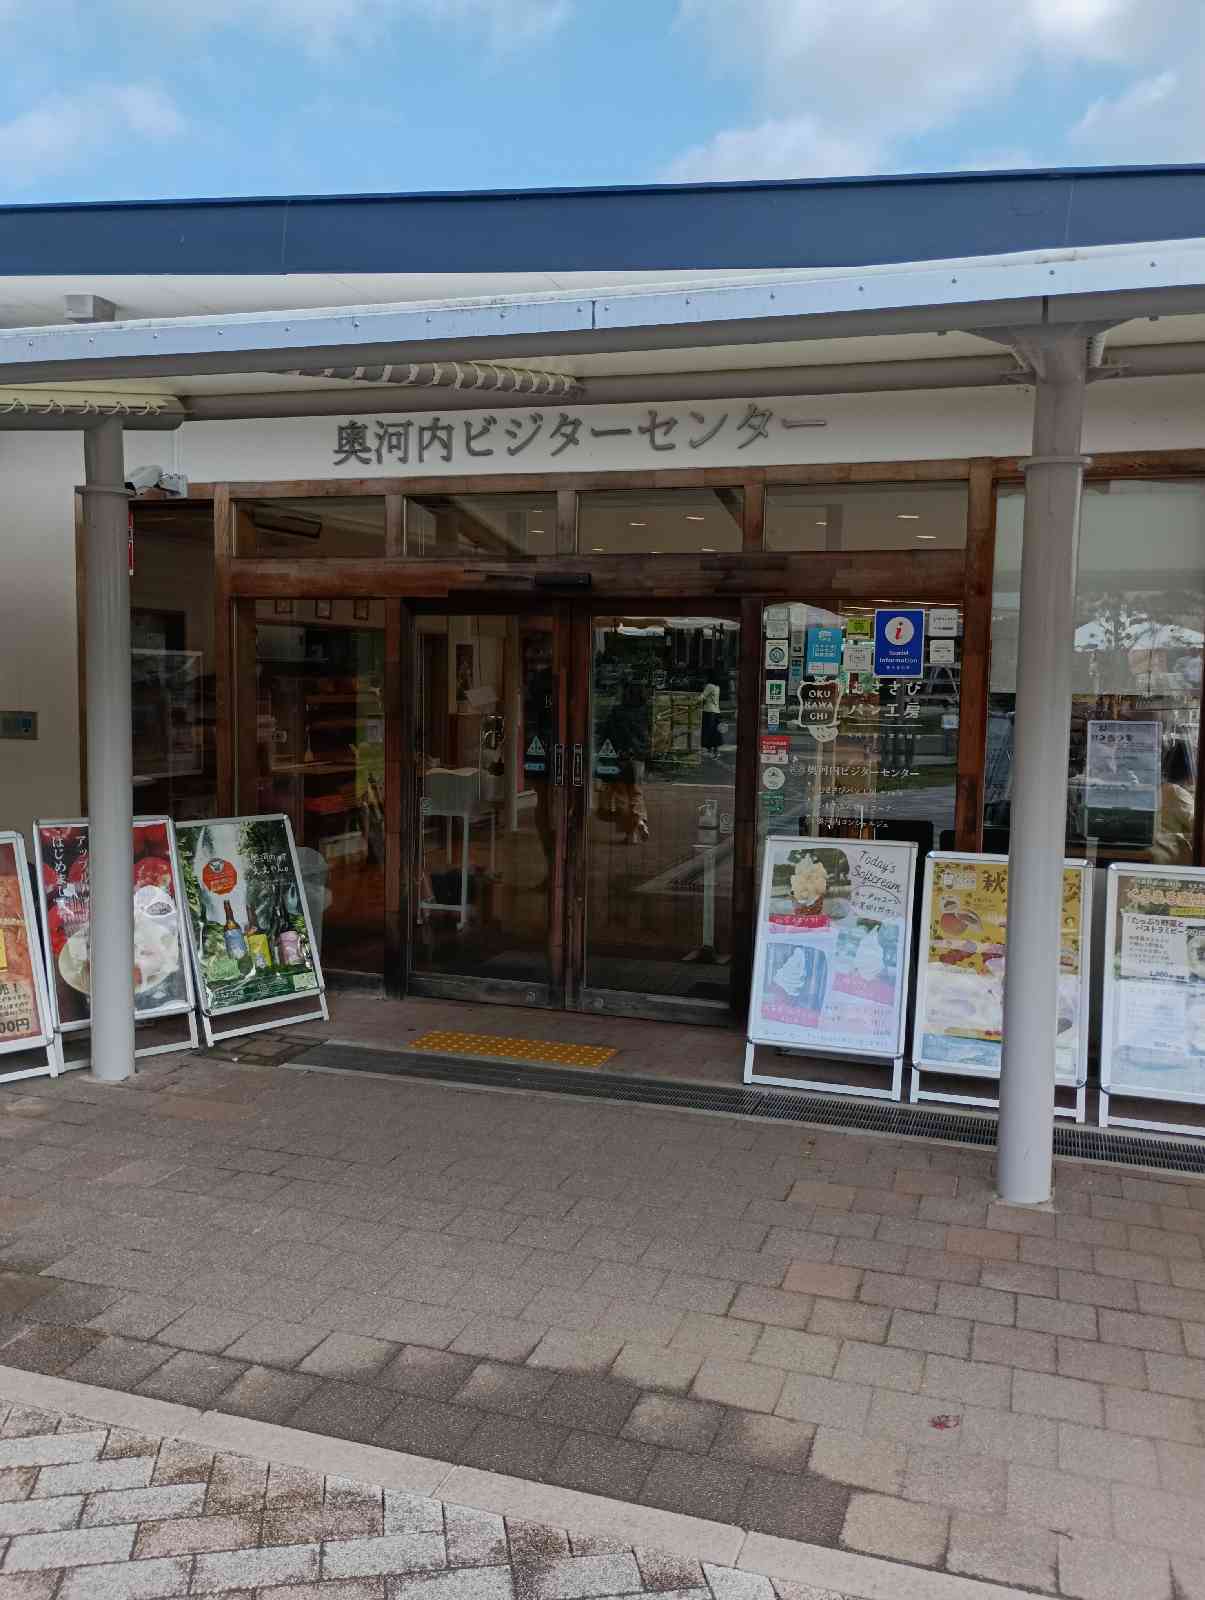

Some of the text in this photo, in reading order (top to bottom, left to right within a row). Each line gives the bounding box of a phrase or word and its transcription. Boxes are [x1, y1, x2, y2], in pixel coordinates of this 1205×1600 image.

[332, 404, 828, 466] 奥河内ビジターセンター
[808, 690, 831, 699] OKU
[804, 702, 834, 711] KAWA
[809, 711, 828, 721] CHI
